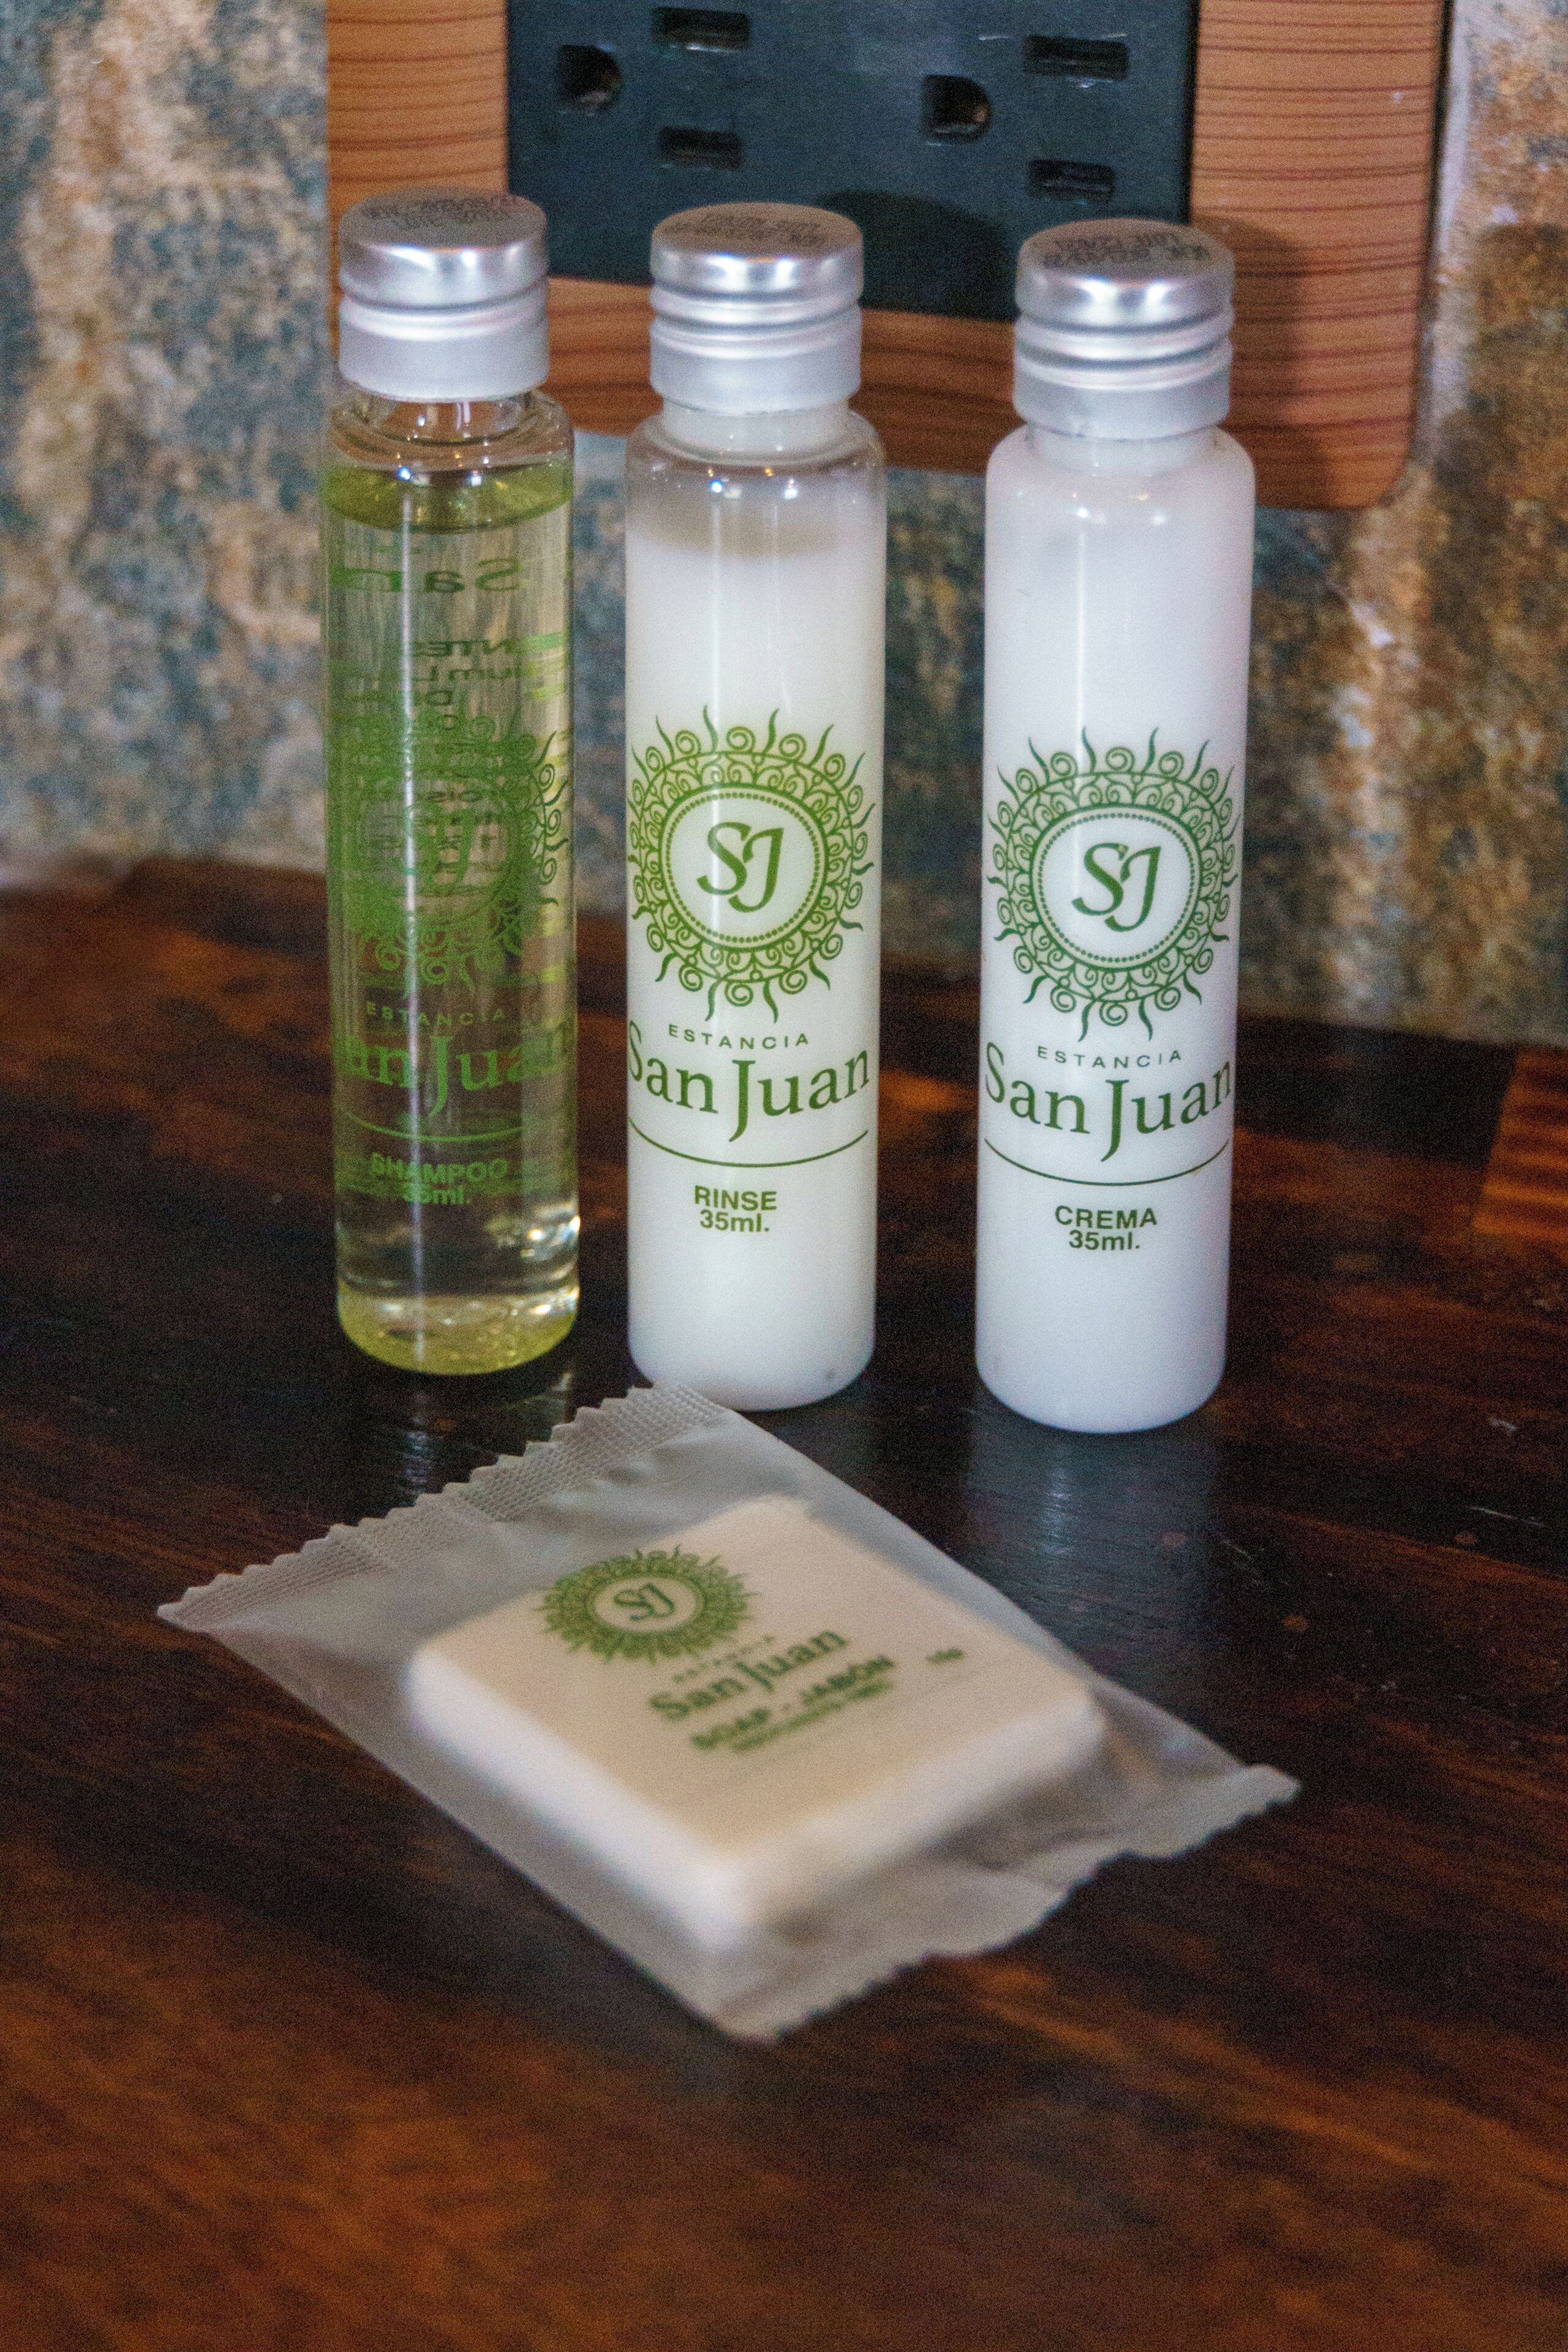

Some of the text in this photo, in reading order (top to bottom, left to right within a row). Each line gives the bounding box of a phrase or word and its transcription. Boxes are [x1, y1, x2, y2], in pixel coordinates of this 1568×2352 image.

[697, 822, 785, 913] SJ
[1072, 842, 1161, 932] SJ
[668, 1024, 809, 1050] ESTANCIA
[1037, 1046, 1182, 1069] ESTANCIA
[628, 1020, 870, 1143] San Juan
[985, 1041, 1231, 1162] San Juan
[370, 1152, 508, 1185] SHAMPOO
[694, 1185, 777, 1211] RINSE
[699, 1208, 770, 1232] 35ml.
[1055, 1205, 1158, 1230] CREMA
[1069, 1229, 1140, 1251] 35ml.
[734, 1629, 851, 1693] Juan
